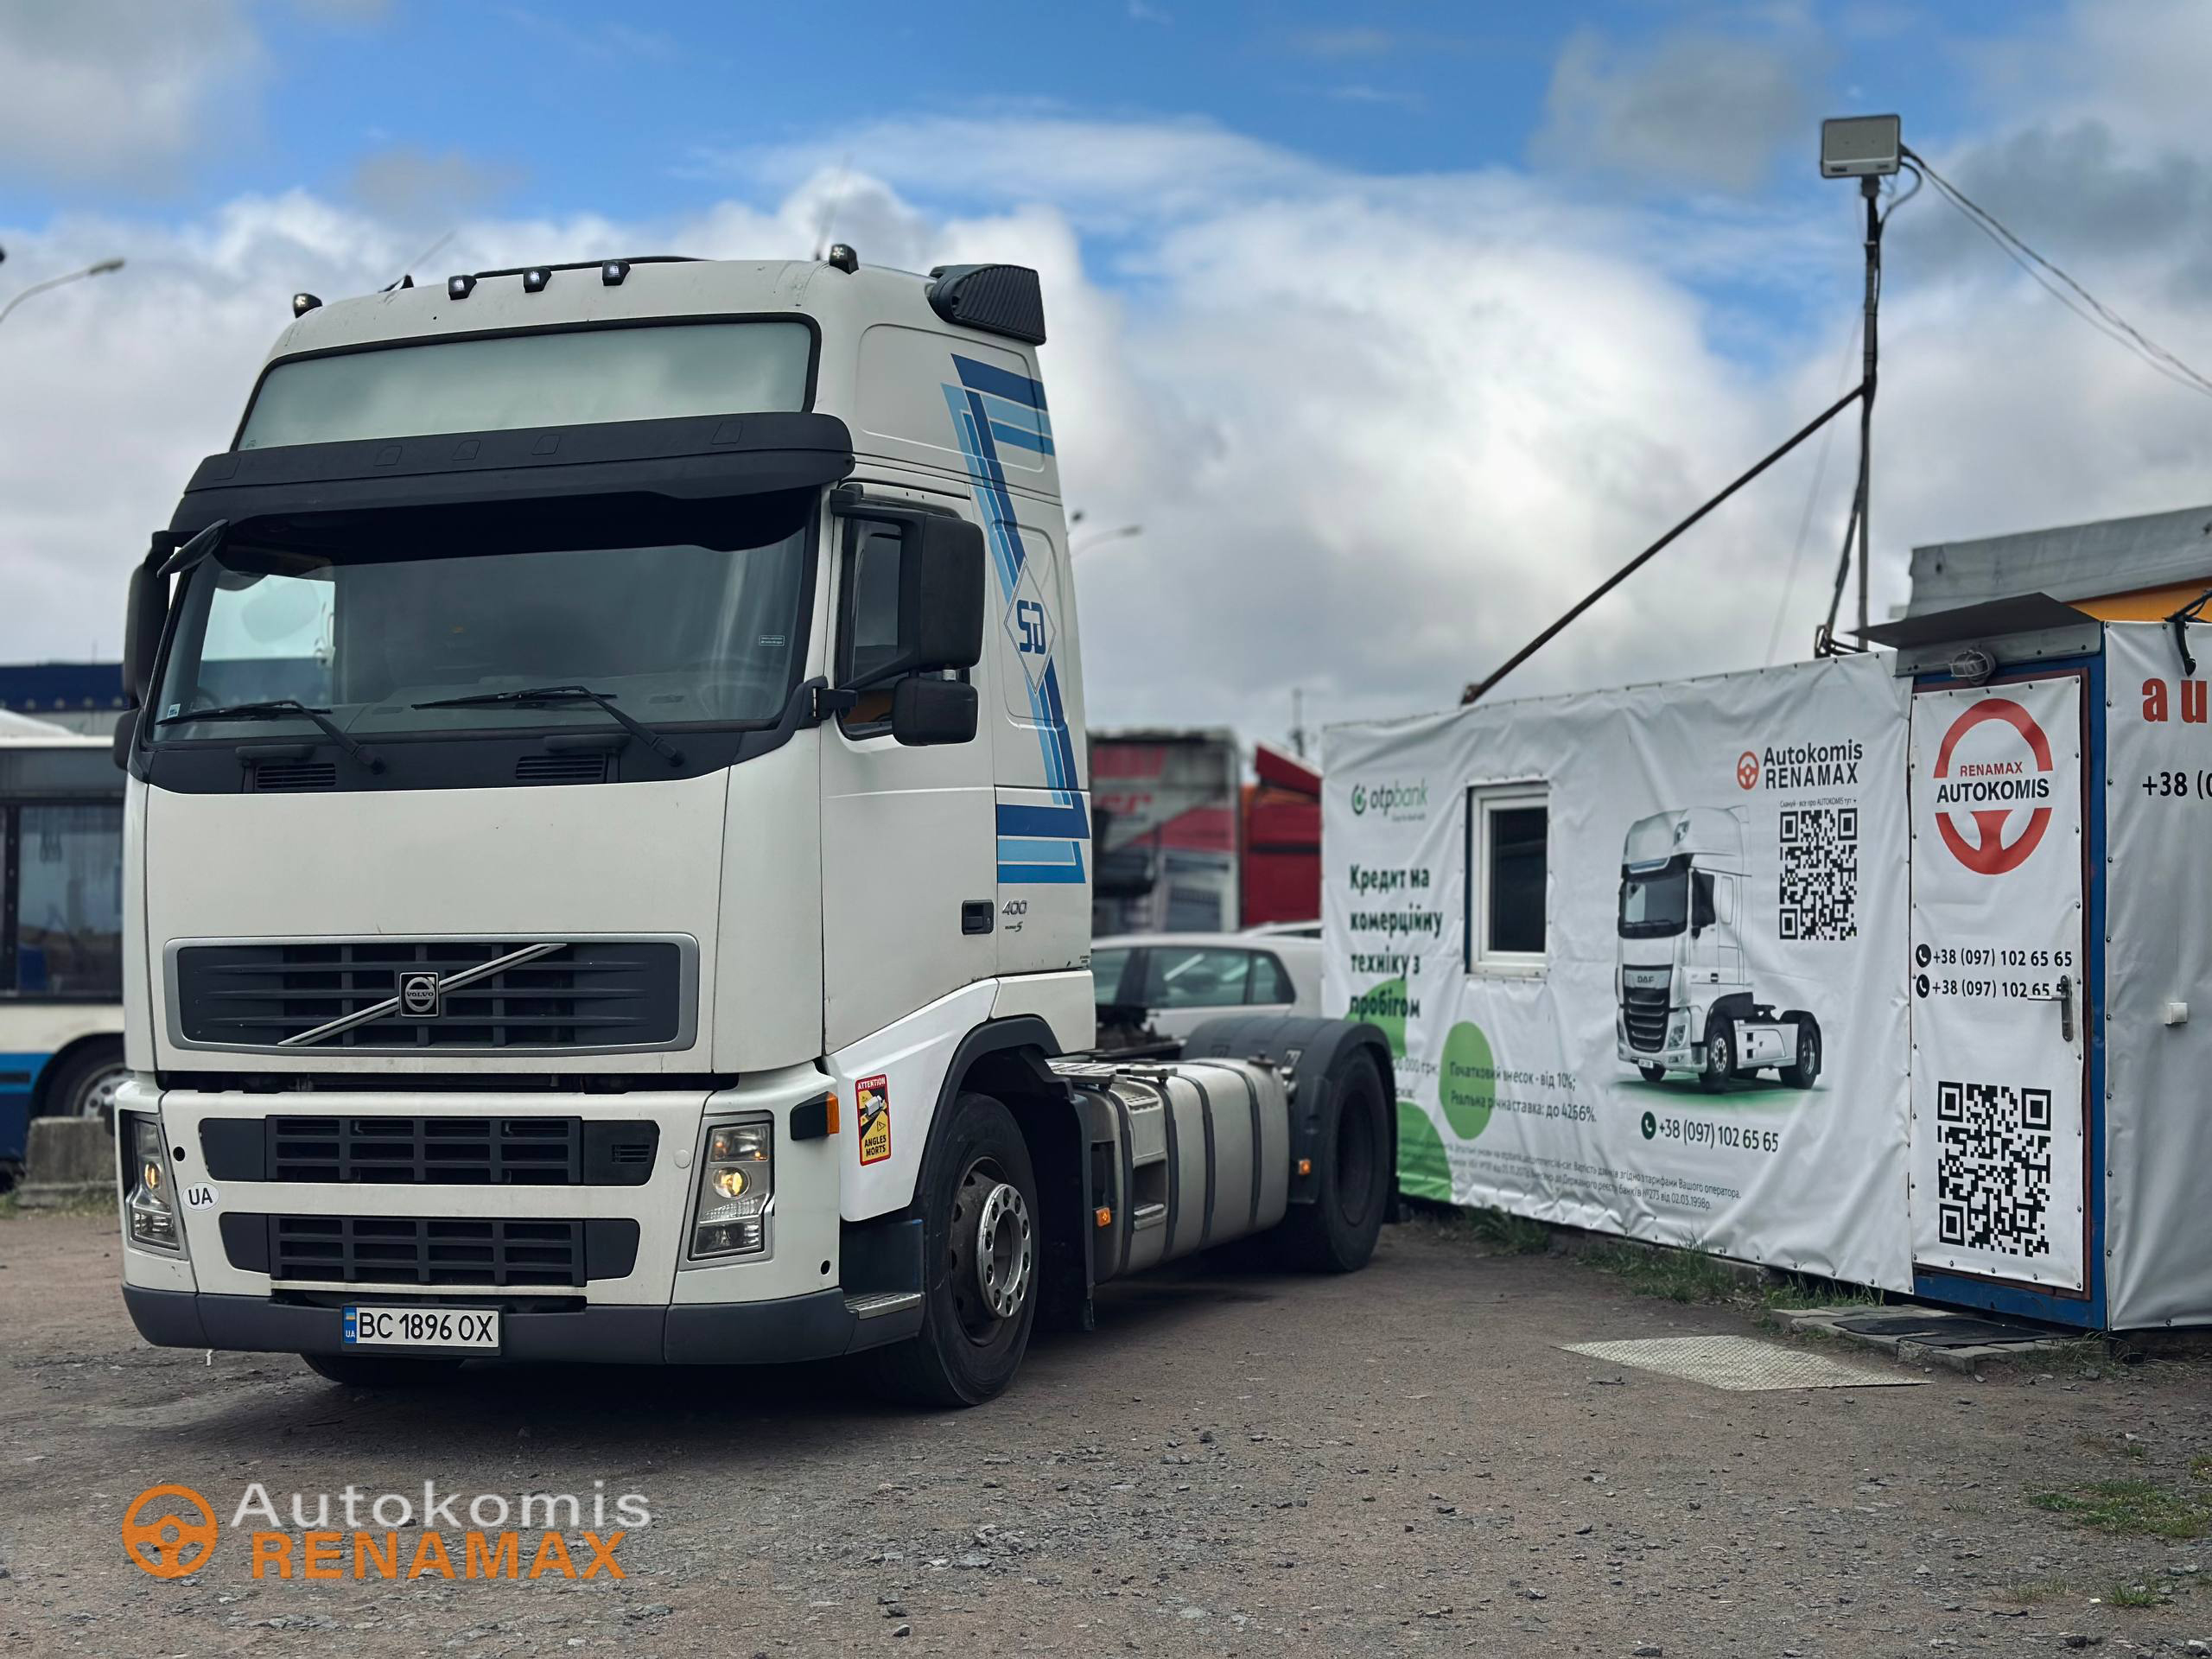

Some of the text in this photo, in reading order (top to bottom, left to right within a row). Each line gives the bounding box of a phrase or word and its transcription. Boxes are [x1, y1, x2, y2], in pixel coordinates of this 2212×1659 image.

[1764, 739, 1863, 767] Autokomis
[1765, 762, 1859, 790] RENAMAX
[1960, 761, 2023, 777] RENAMAX
[1936, 779, 2050, 804] AUTOKOMIS
[2142, 771, 2188, 797] +38
[1350, 865, 1429, 896] Кредит на
[1002, 900, 1027, 915] 400
[1350, 904, 1443, 938] комерційну
[1351, 946, 1420, 981] техніку з
[1934, 948, 2072, 967] +38 (097) 102 65 65
[1932, 980, 1957, 995] +38
[1962, 979, 1996, 998] (097)
[2002, 982, 2027, 997] 102
[2032, 983, 2050, 995] 65
[1350, 990, 1420, 1020] пробігом
[858, 1077, 886, 1090] ATTENTION
[1503, 1070, 1534, 1085] внесок
[1541, 1071, 1554, 1089] від
[1546, 1105, 1560, 1120] до
[864, 1135, 887, 1147] ANGLES
[1659, 1119, 1779, 1153] +38 (097) 102 65 65
[866, 1145, 886, 1156] MORTS
[188, 1187, 213, 1205] UA
[359, 1313, 493, 1341] BC 1896 OX
